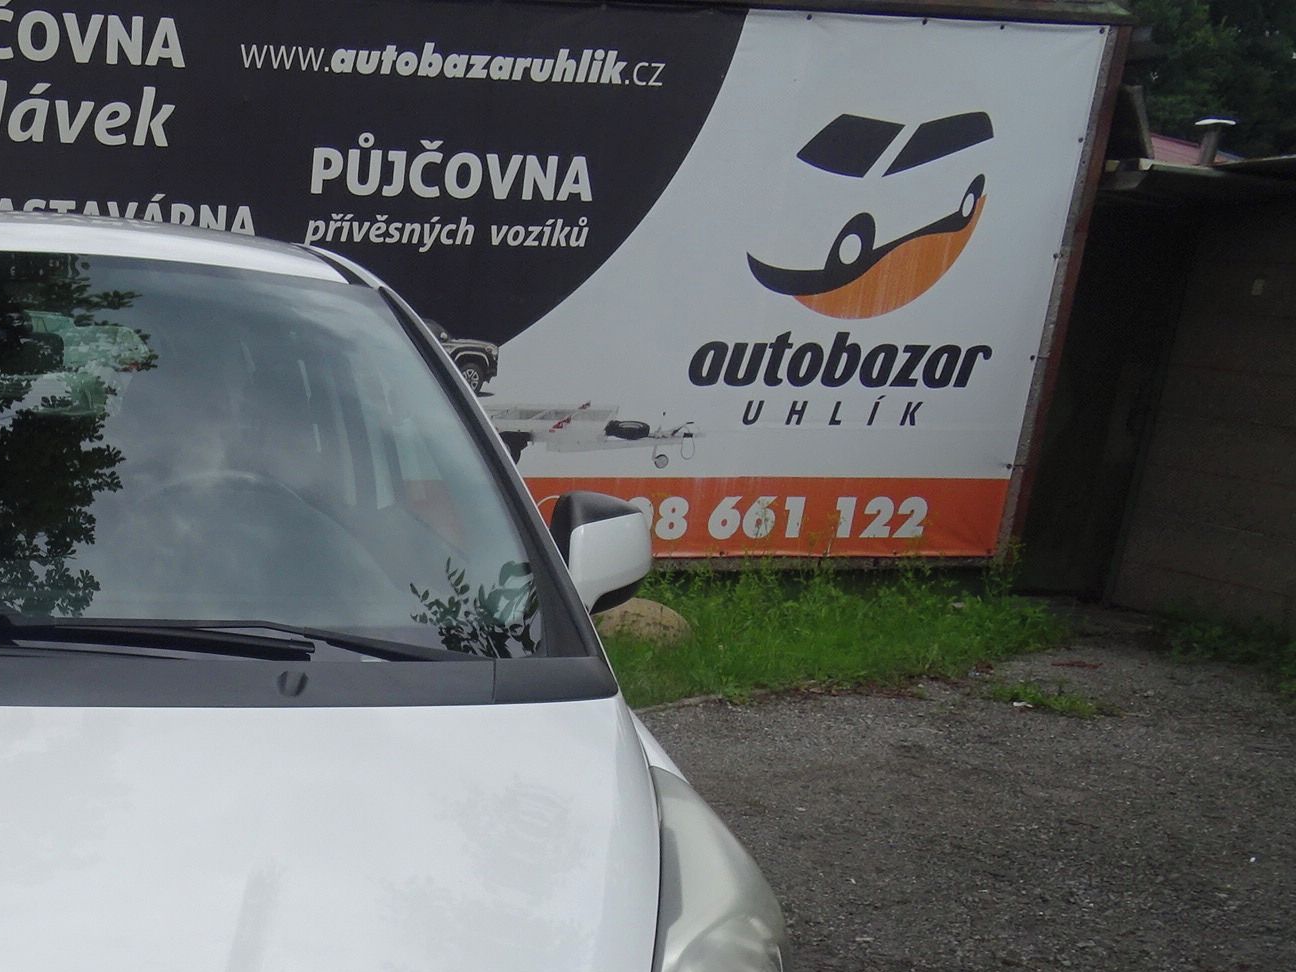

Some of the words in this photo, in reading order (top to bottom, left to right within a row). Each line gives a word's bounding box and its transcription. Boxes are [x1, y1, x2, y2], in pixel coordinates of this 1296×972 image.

[240, 42, 666, 87] www.autobazaruhlik.cz
[310, 132, 593, 202] PŮJČOVNA
[304, 212, 476, 253] přívěsných
[490, 216, 590, 248] vozíků
[688, 330, 993, 389] autobazar
[741, 395, 924, 427] UHLÍK
[707, 495, 807, 541] 661
[835, 495, 929, 539] 122
